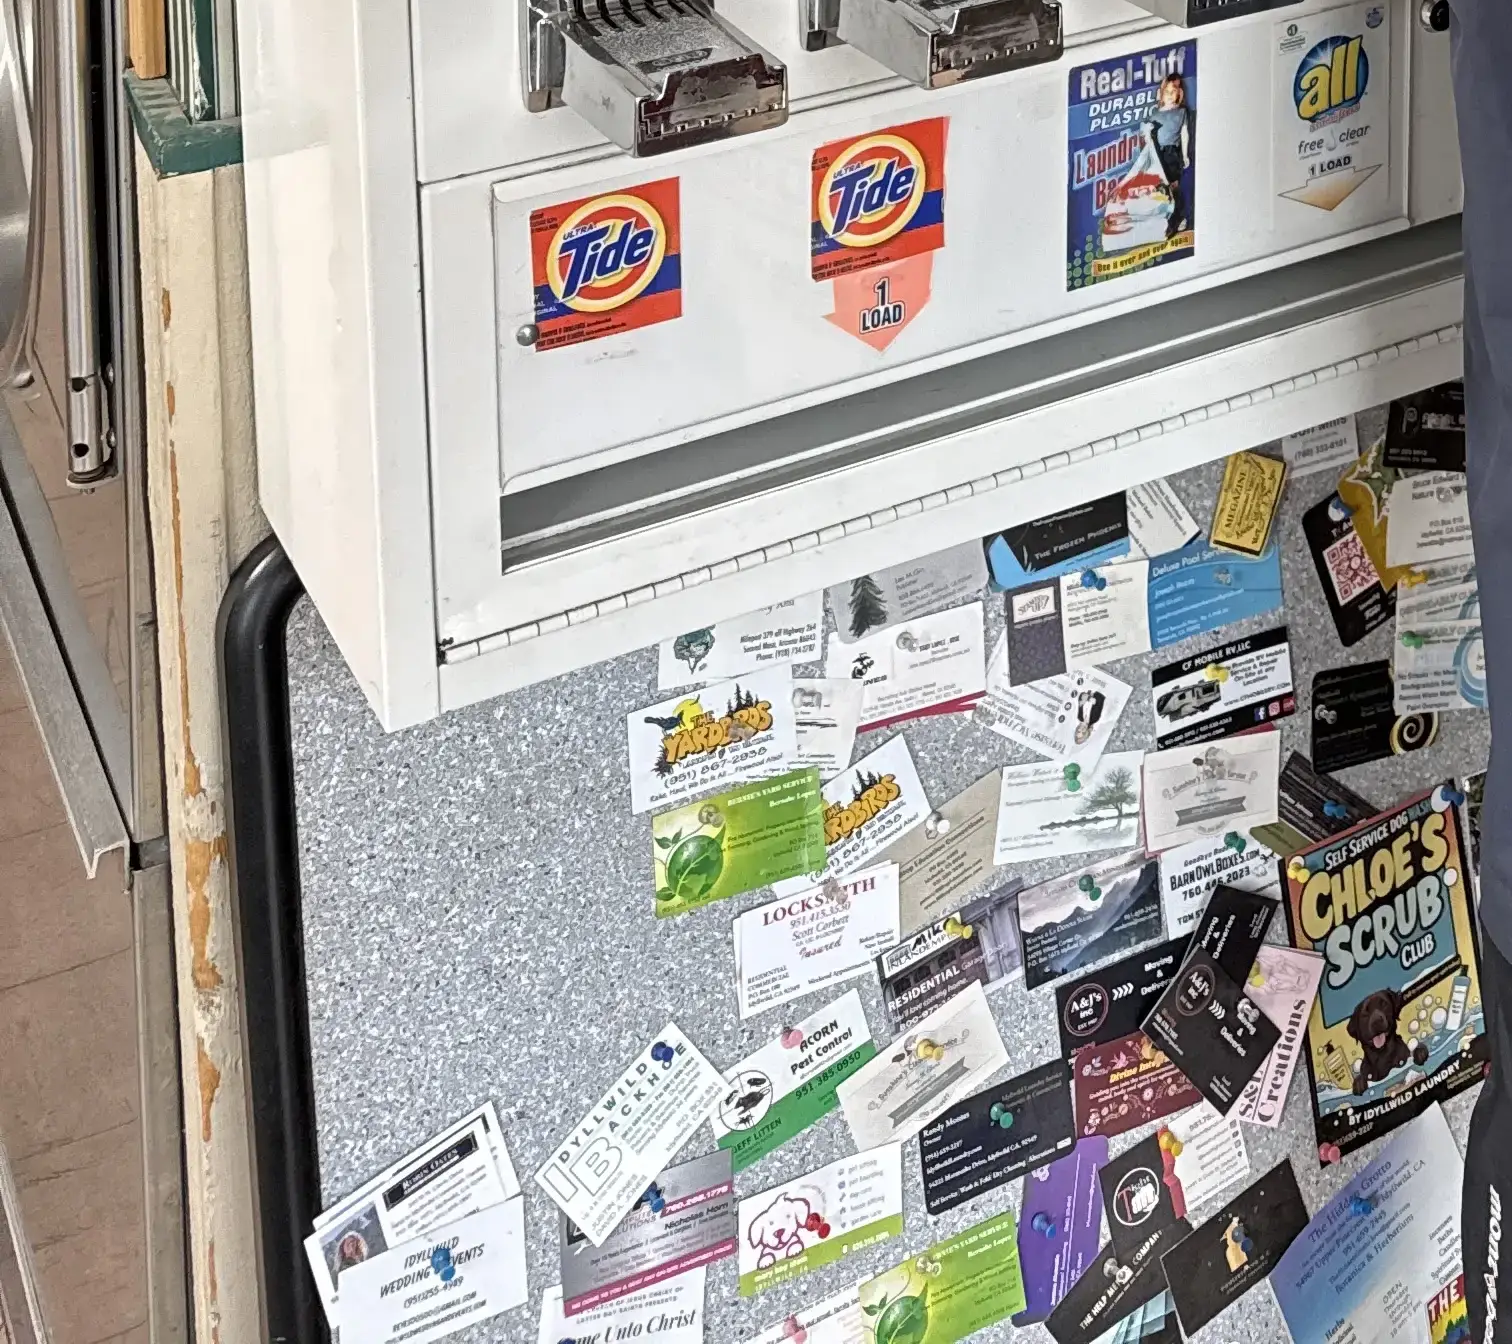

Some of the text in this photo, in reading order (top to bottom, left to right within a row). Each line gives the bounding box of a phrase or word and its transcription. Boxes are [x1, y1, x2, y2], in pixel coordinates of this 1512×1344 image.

[1080, 45, 1187, 101] Real-Tuff
[1297, 34, 1364, 120] all
[1088, 88, 1160, 118] DURABL
[1298, 124, 1371, 155] free clear
[1320, 156, 1352, 173] LOAD
[828, 156, 919, 238] Tide
[563, 222, 596, 241] ULTRA
[557, 217, 657, 303] Tide
[874, 278, 888, 307] 1
[861, 304, 903, 332] LOAD
[1053, 536, 1085, 554] FROZEN
[1152, 554, 1200, 578] Deluxe Pool
[1195, 649, 1224, 667] MOBILE
[1325, 811, 1409, 872] SELF SERVICE DOG
[1301, 813, 1448, 940] CHLOE'S
[762, 876, 877, 927] LOCKSTH
[791, 915, 850, 942] Scott Corbett
[1211, 914, 1237, 960] Deliveries
[1325, 874, 1443, 989] SCRUB
[1144, 955, 1174, 973] Moving
[1401, 932, 1436, 968] CLUB
[887, 965, 961, 1013] RESIDENTIAL
[790, 1026, 853, 1076] Pest Control
[800, 1019, 839, 1054] ACORN
[1219, 1025, 1247, 1058] Deliveries
[1257, 997, 1308, 1123] Creations
[1348, 1060, 1461, 1126] BY IDYLLWILD LAUNDRY
[1307, 1160, 1393, 1244] The Grotto
[663, 1212, 704, 1231] Nicholas
[379, 1243, 486, 1299] WEDDING VENTS
[1079, 1293, 1108, 1331] THE HELP
[1428, 1279, 1461, 1322] THE
[604, 1309, 697, 1344] Unto Christ
